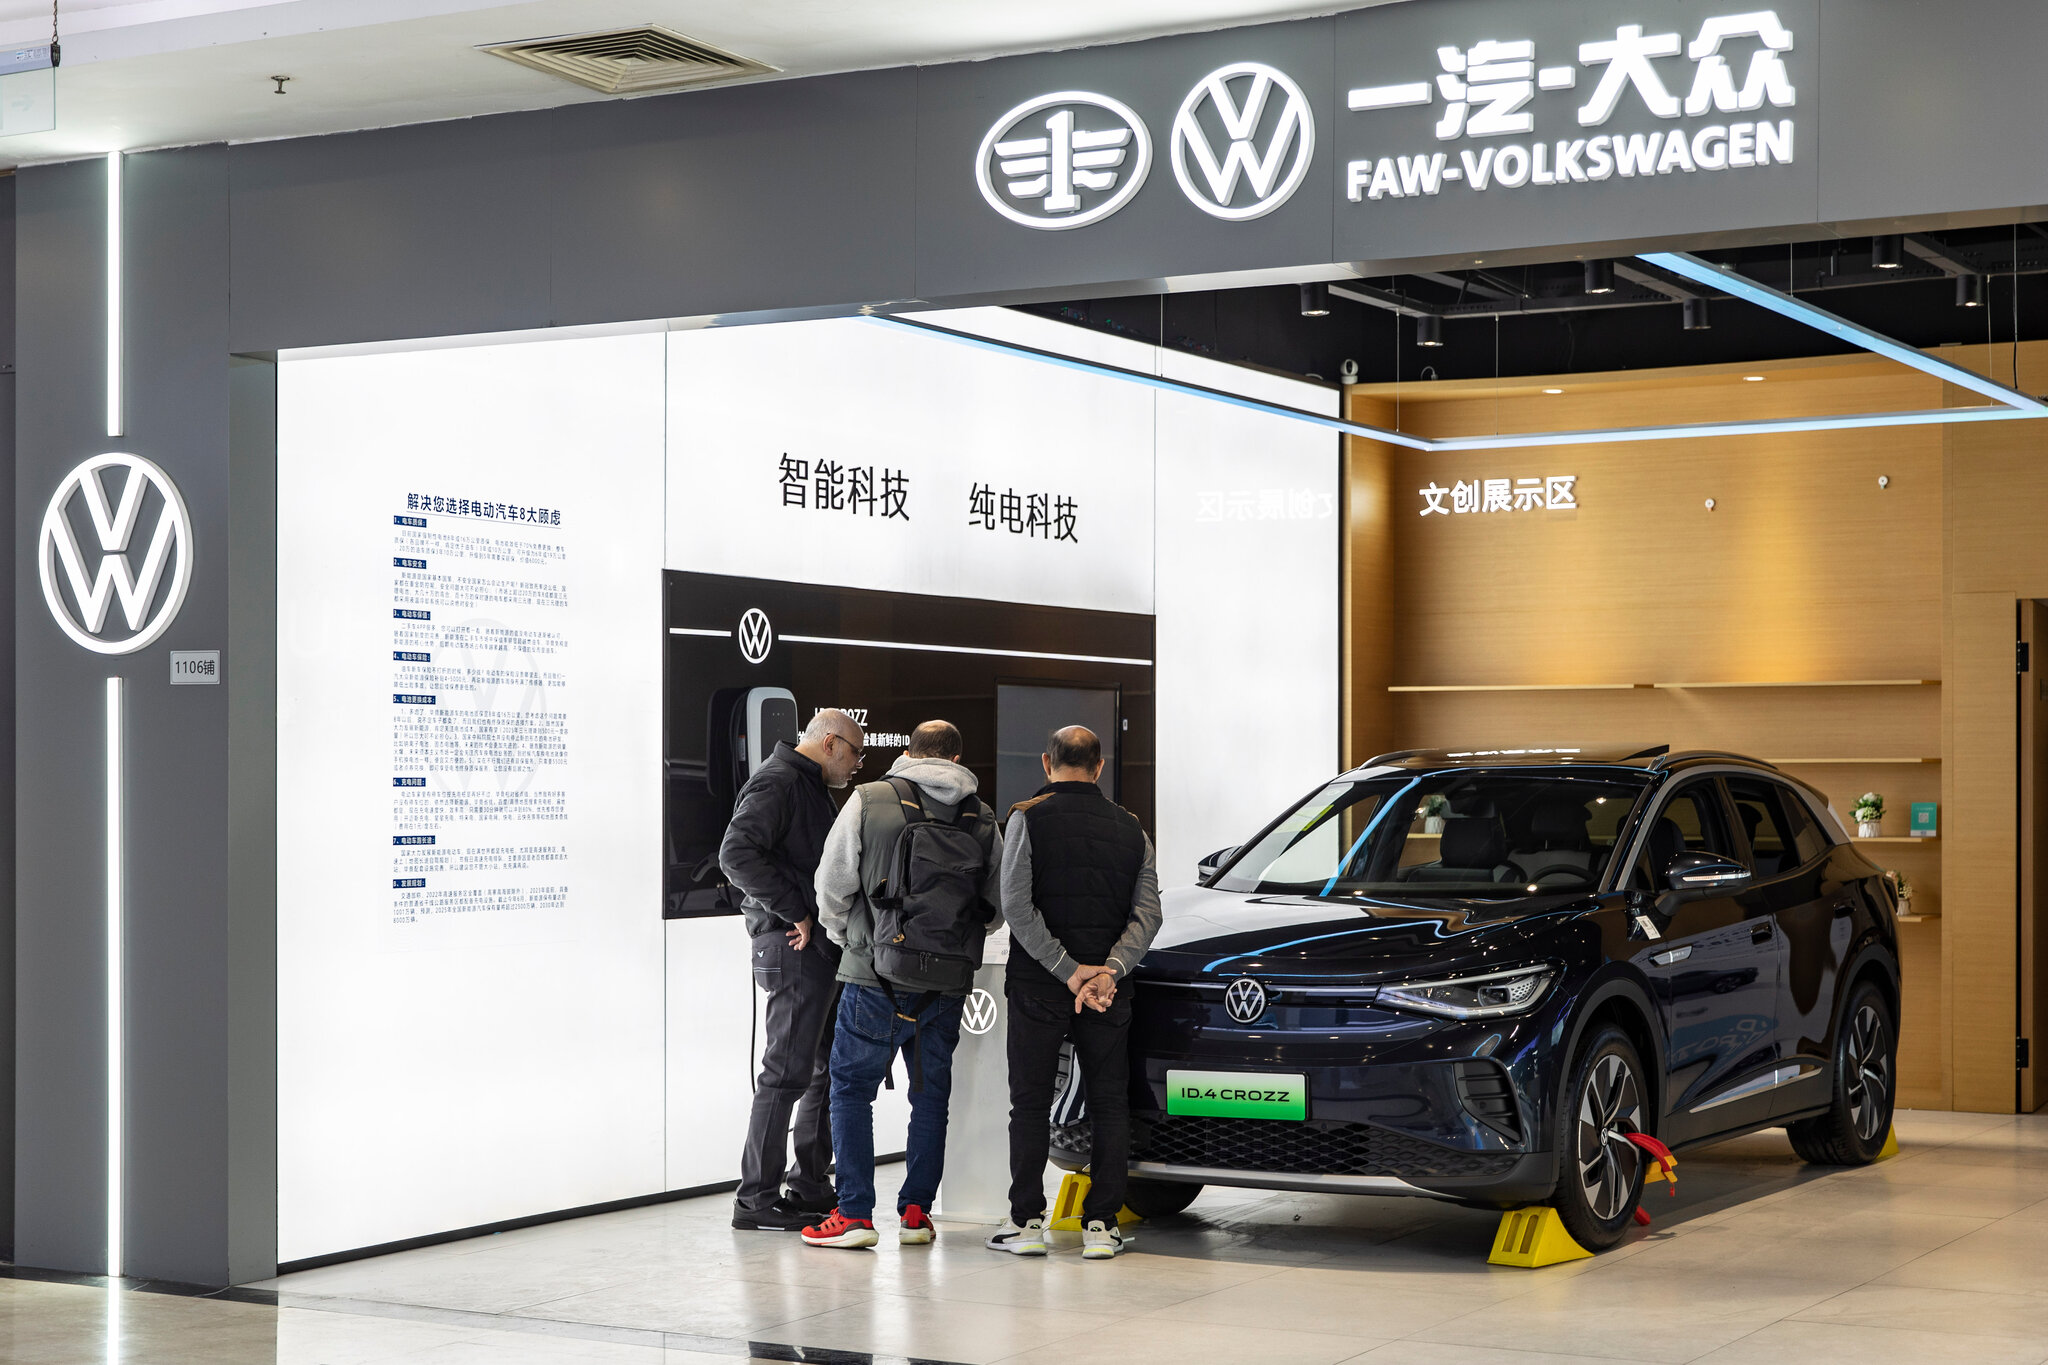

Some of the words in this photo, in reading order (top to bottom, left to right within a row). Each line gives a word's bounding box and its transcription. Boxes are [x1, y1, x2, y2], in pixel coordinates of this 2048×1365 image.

[1347, 10, 1796, 140] 一汽-大众
[1347, 119, 1795, 202] FAW-VOLKSWAGEN
[407, 492, 561, 526] 解决您选择电动汽车8大顾虑
[778, 452, 910, 522] 智能科技
[968, 482, 1079, 544] 纯电科技
[1418, 475, 1578, 517] 文创展示区
[175, 660, 215, 675] 1106铺
[1181, 1087, 1217, 1099] ID.4
[1220, 1089, 1290, 1102] CROZZ
